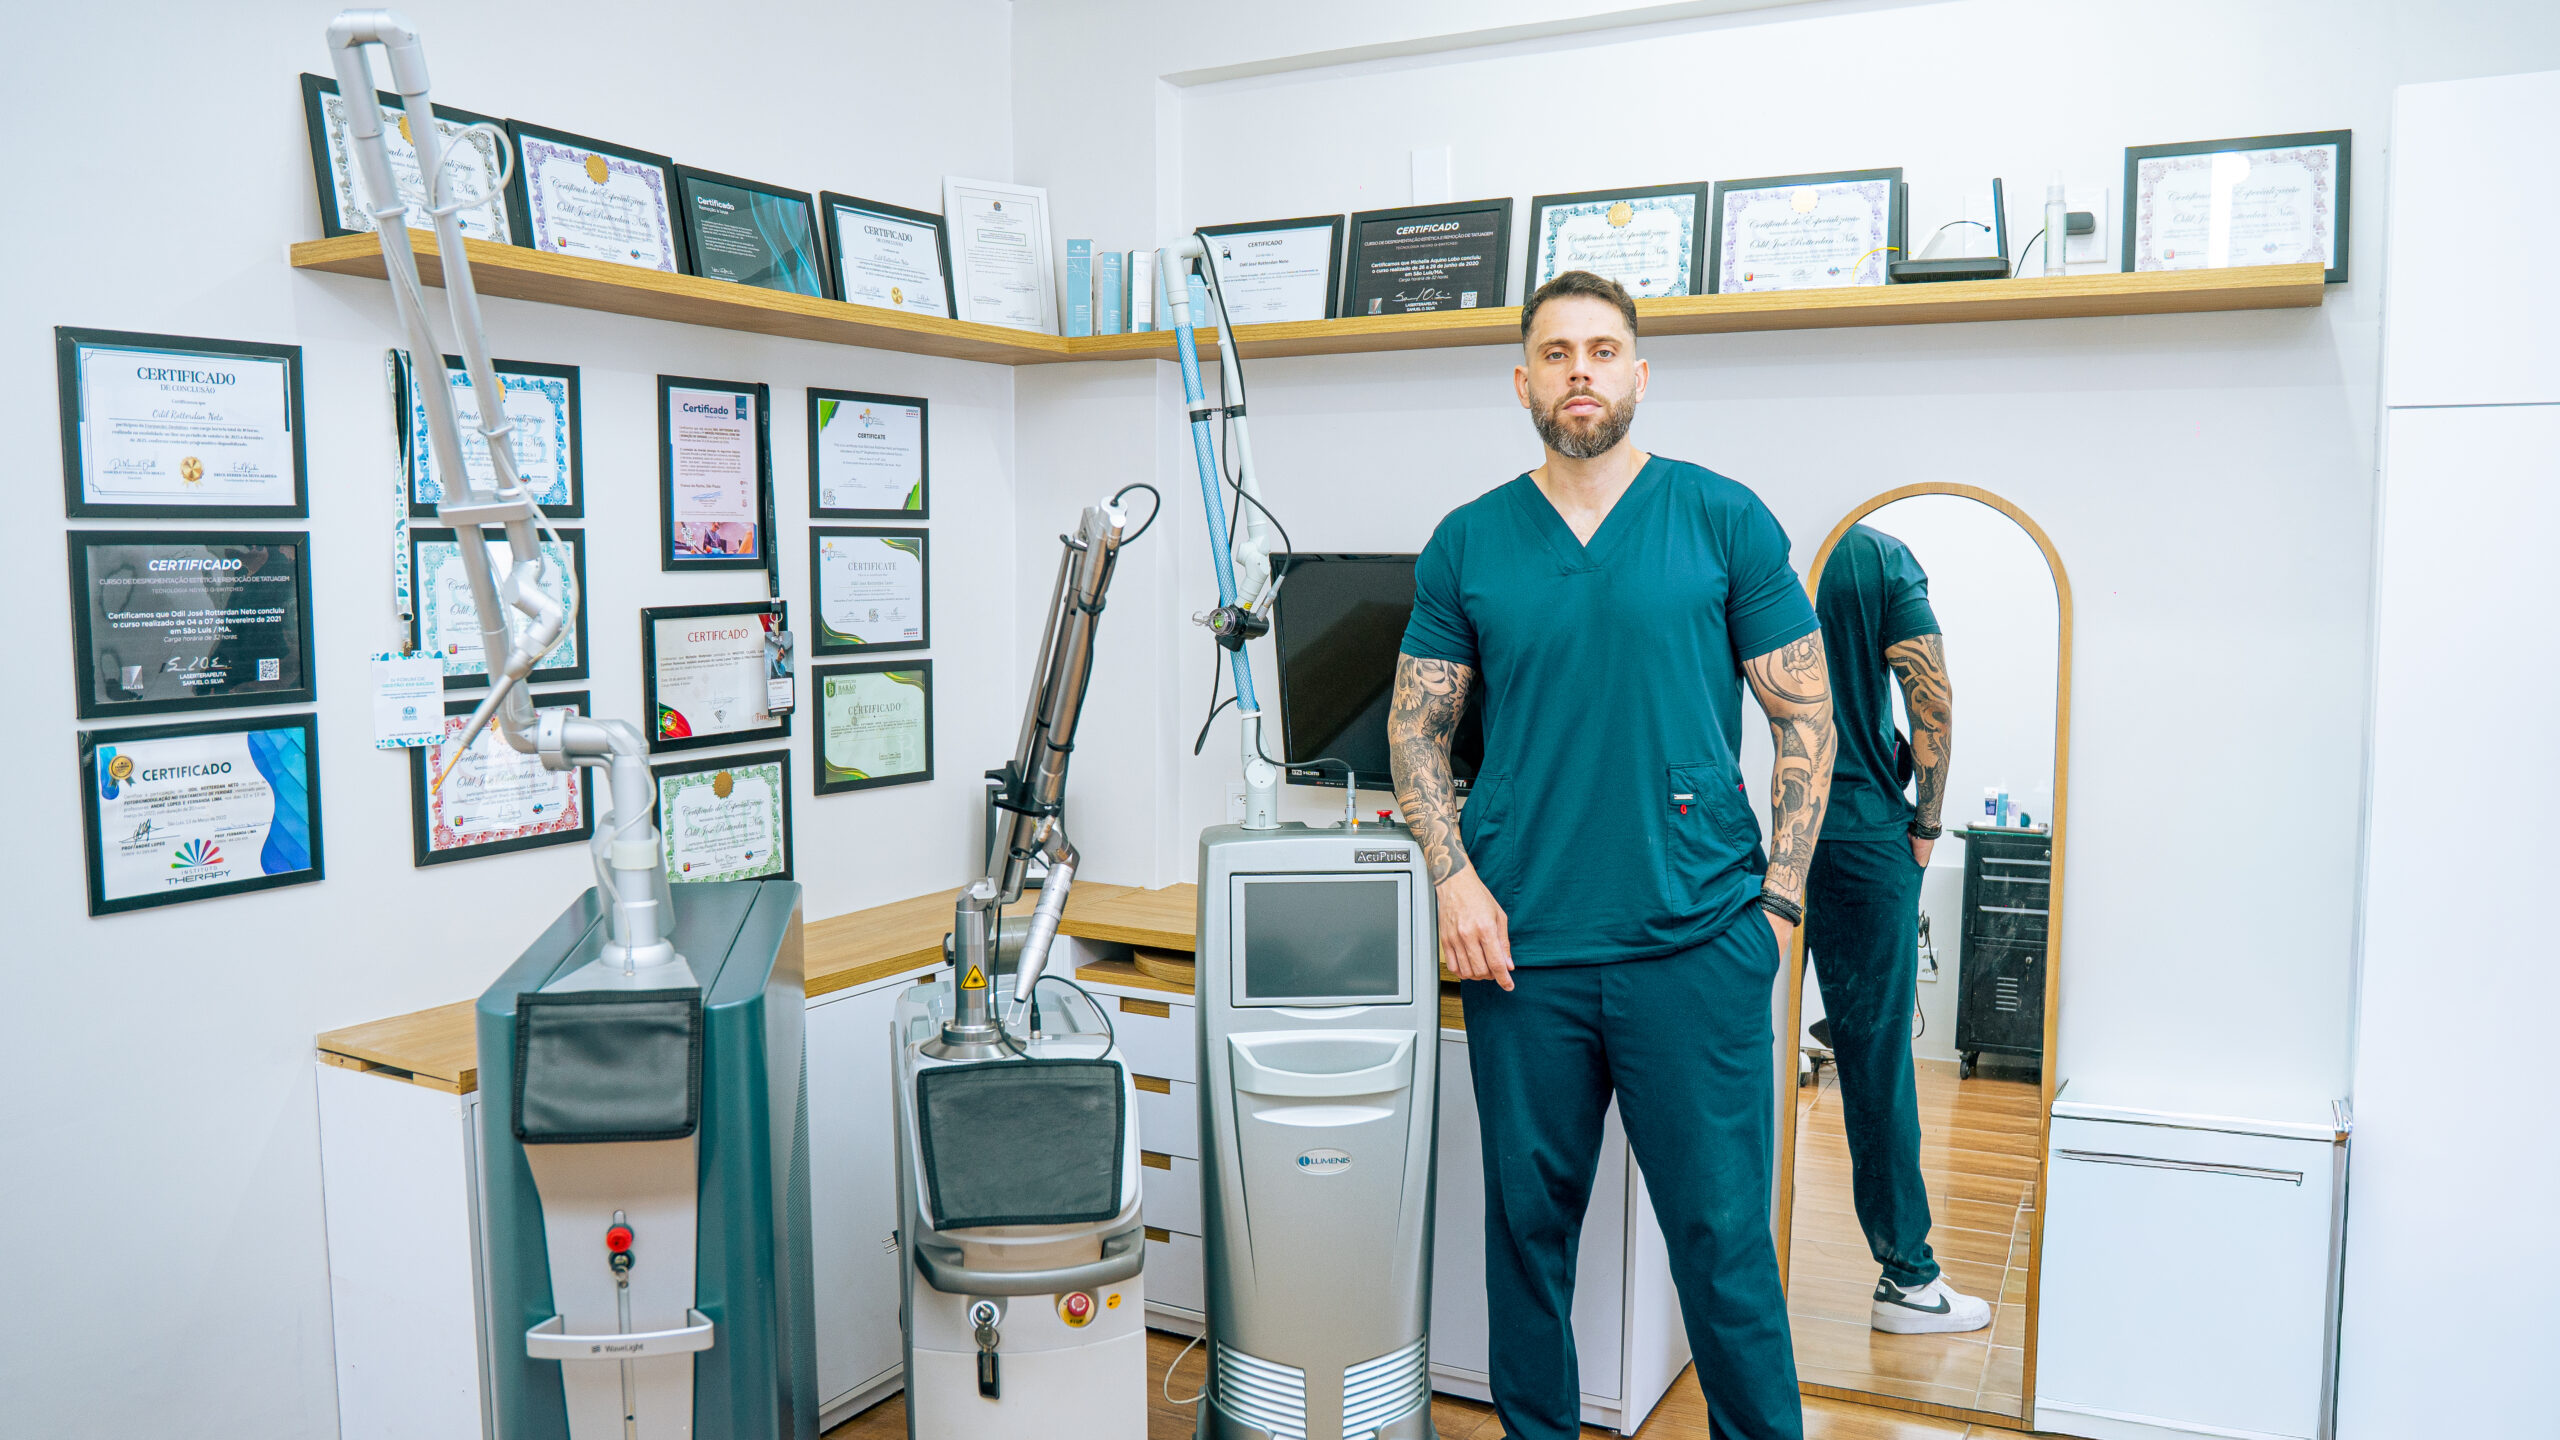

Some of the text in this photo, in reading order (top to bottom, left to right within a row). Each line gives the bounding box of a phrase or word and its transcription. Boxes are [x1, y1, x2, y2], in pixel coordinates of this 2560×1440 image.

[550, 176, 588, 194] Certificado
[697, 196, 735, 211] Certificado
[864, 226, 912, 242] CERTIFICADO
[1396, 222, 1460, 236] CERTIFICADO
[1248, 239, 1283, 248] CERTIFICADO
[136, 366, 236, 386] CERTIFICADO
[160, 384, 216, 394] DE CONCLUSÃO
[682, 402, 729, 415] Certificado
[857, 432, 886, 440] CERTIFICATE
[148, 558, 242, 572] CERTIFICADO
[848, 562, 897, 572] CERTIFICATE
[108, 611, 154, 620] Certificamos
[156, 612, 169, 620] que
[171, 610, 186, 618] Odil
[187, 609, 203, 617] José
[205, 608, 239, 616] Rotterdan
[257, 607, 285, 615] concluiu
[141, 618, 174, 627] realizado
[176, 618, 185, 626] de
[225, 616, 255, 624] fevereiro
[183, 626, 197, 634] São
[688, 628, 748, 643] CERTIFICADO
[163, 636, 182, 644] Carga
[182, 679, 204, 687] SAMUEL
[848, 702, 902, 716] CERTIFICADO
[142, 762, 232, 782] CERTIFICADO
[1357, 851, 1408, 862] AcuPulse
[181, 865, 218, 875] INSTITUTO
[165, 870, 231, 886] THERAPY
[1310, 1157, 1350, 1165] LUMENIS
[605, 1343, 644, 1353] WaveLight
